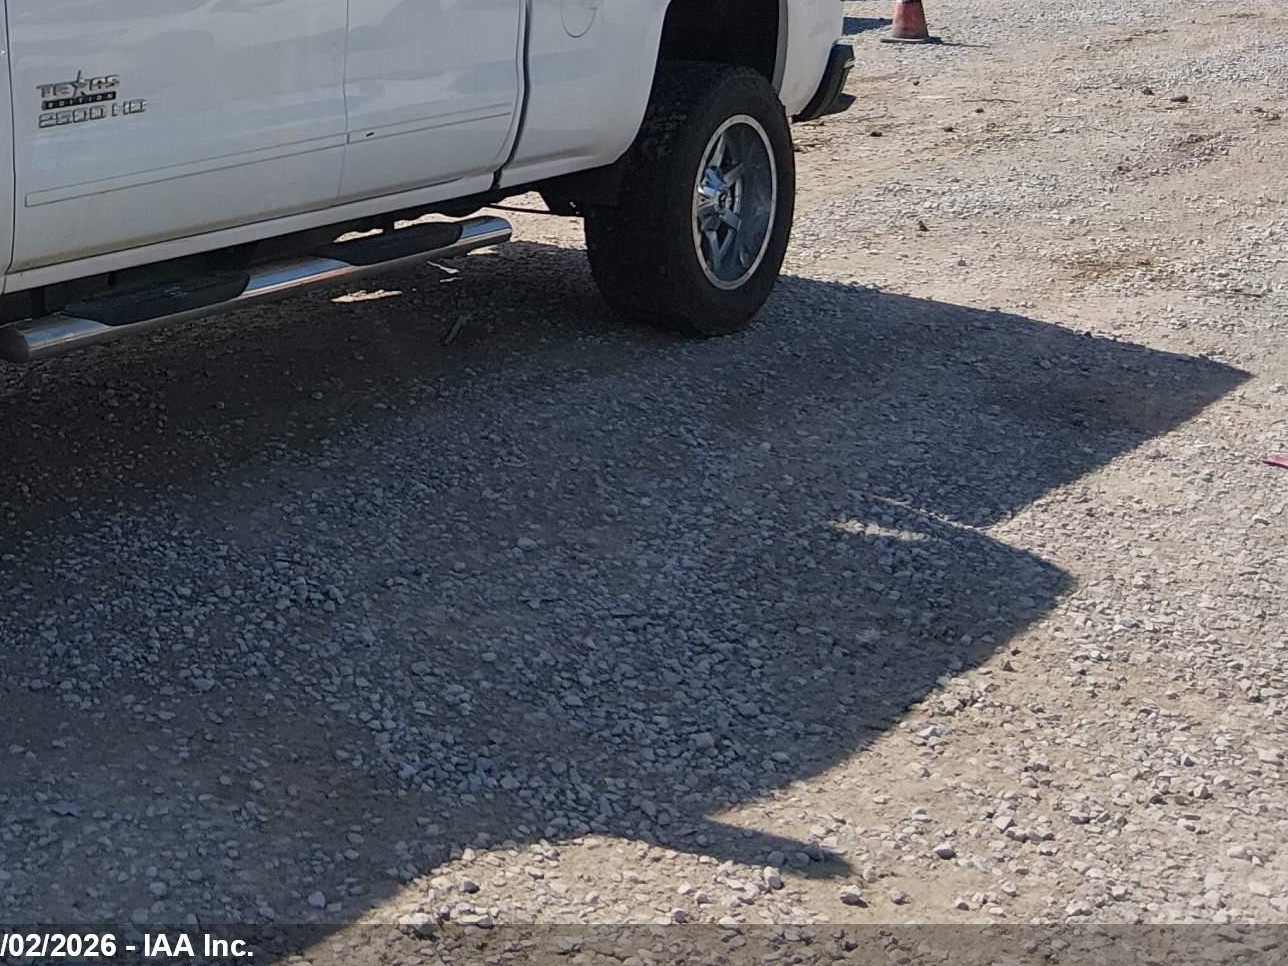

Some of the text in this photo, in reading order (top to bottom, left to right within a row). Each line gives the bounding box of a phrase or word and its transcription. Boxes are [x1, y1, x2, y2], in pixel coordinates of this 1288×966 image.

[37, 70, 120, 99] TEXAS
[38, 99, 147, 129] 2500 HD
